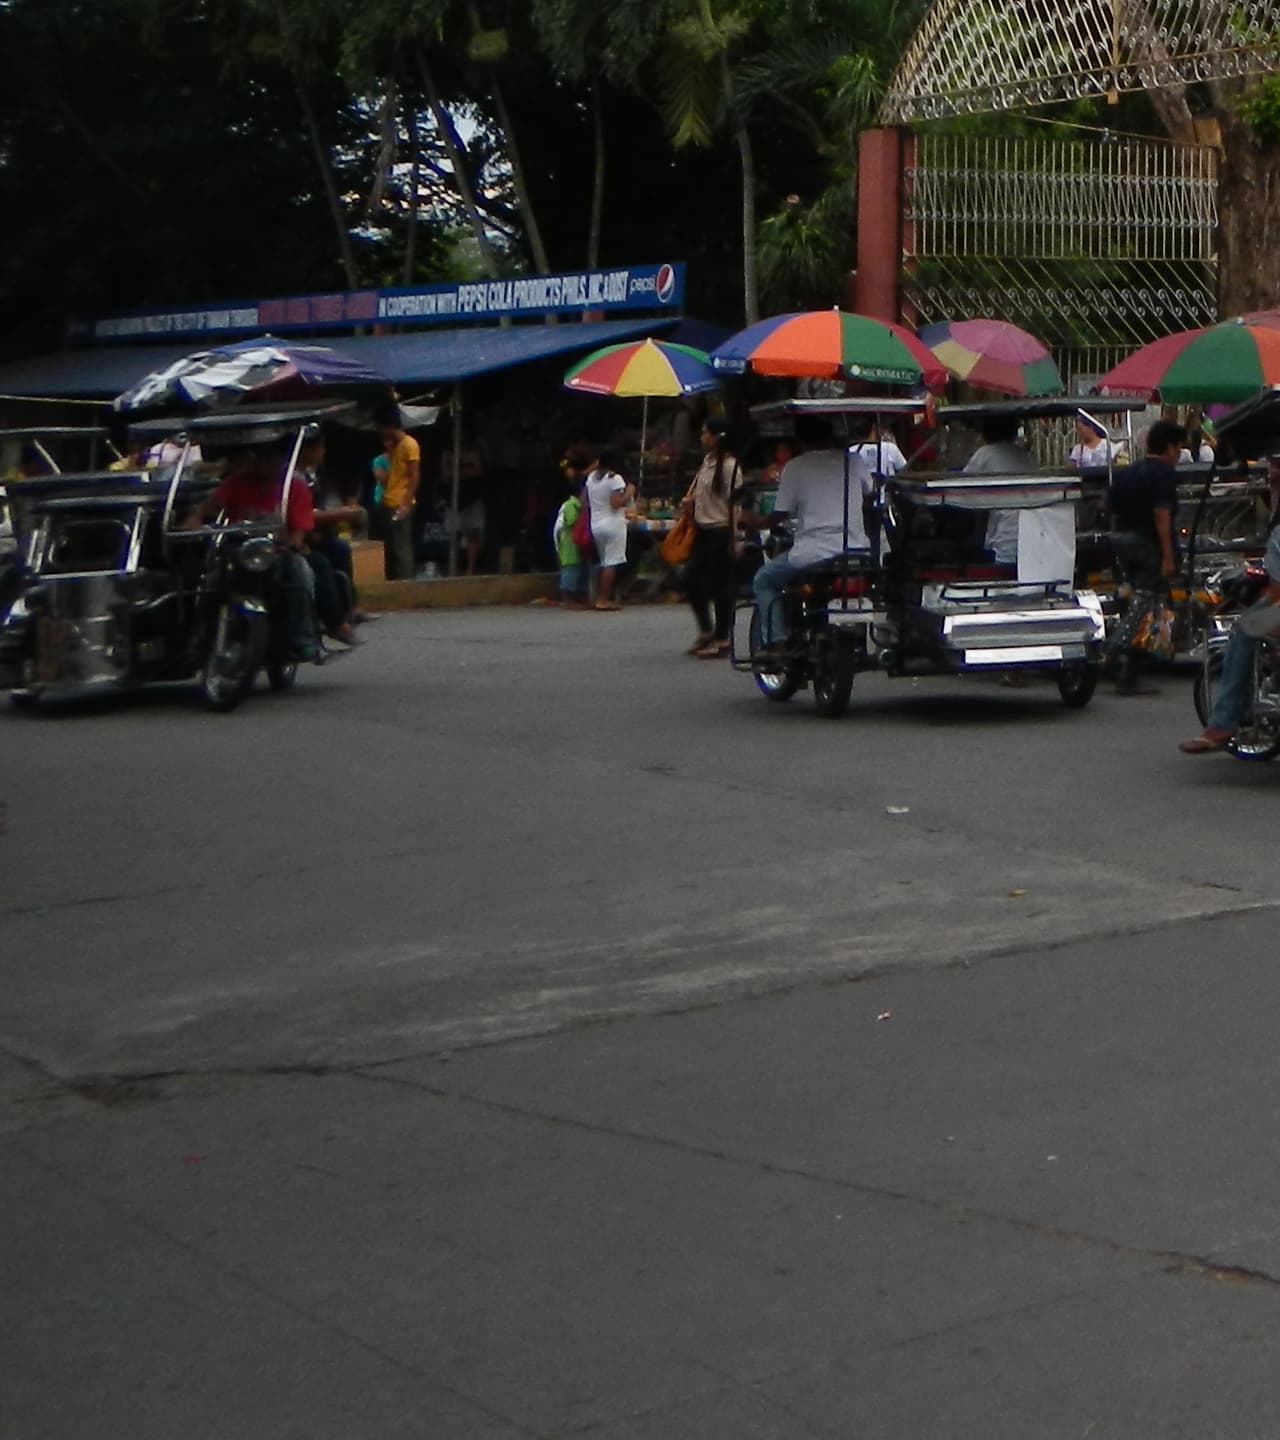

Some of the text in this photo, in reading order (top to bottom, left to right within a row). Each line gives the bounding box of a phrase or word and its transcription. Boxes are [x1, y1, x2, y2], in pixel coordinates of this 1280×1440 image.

[458, 284, 488, 312] PEPSI
[489, 281, 513, 311] COLA
[514, 277, 561, 308] PRODUCTS
[630, 275, 656, 295] pepsi
[862, 367, 915, 380] MICROMATIC
